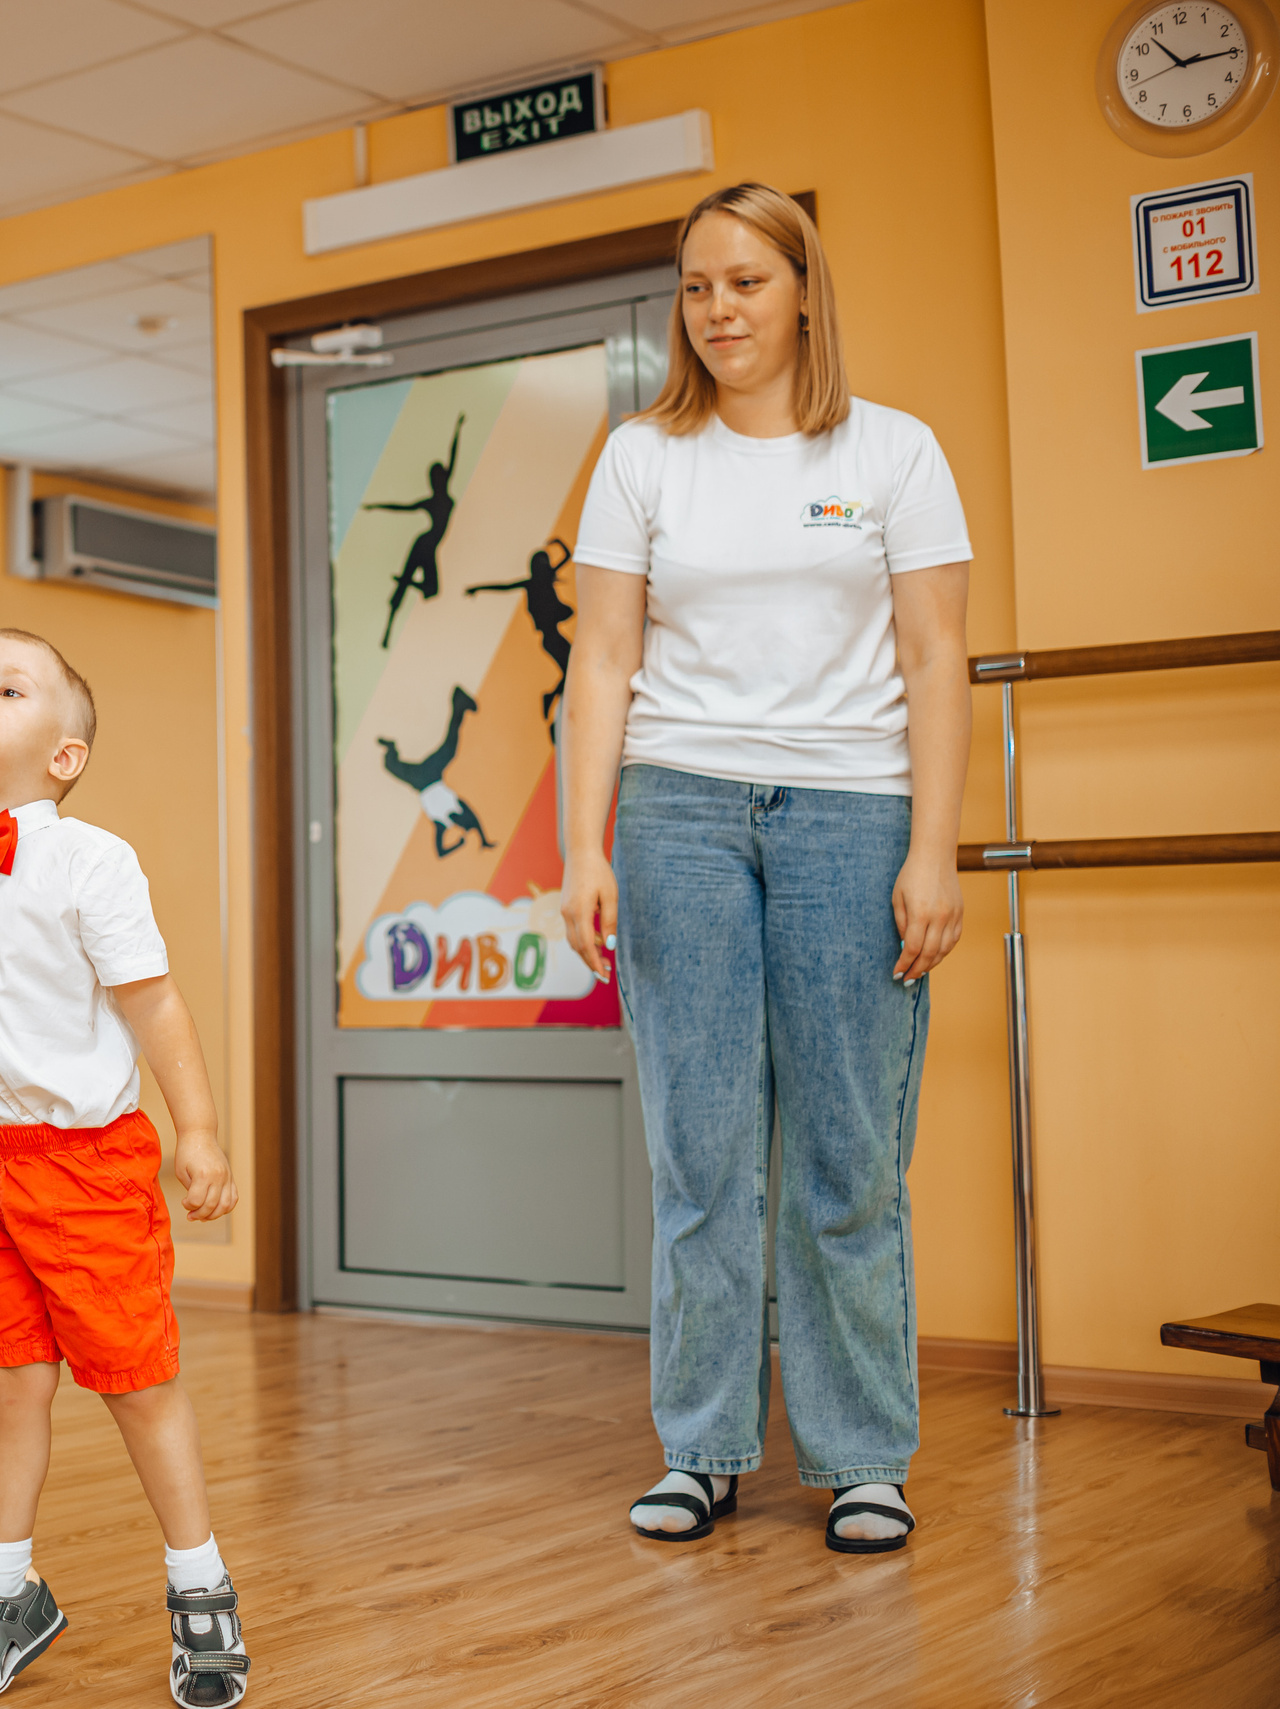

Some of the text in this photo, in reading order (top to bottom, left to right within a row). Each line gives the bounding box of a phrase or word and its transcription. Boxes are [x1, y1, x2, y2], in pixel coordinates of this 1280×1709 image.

[1172, 12, 1187, 25] 12
[1200, 12, 1207, 24] 1
[1151, 22, 1164, 35] 11
[1220, 24, 1229, 37] 2
[1135, 43, 1150, 56] 10
[1229, 47, 1239, 59] 3
[1130, 69, 1139, 81] 9
[1224, 71, 1233, 84] 4
[1139, 90, 1148, 102] 8
[1207, 93, 1216, 106] 5
[462, 84, 583, 134] ВЫХОД
[1159, 103, 1167, 116] 7
[1183, 105, 1192, 117] 6
[480, 115, 565, 150] EXIT
[1160, 209, 1194, 222] ПОЖАРЕ
[1195, 203, 1233, 215] ЗВОНИТЬ
[1182, 217, 1206, 237] 01
[1170, 236, 1226, 252] МОБИЛЬНОГО
[1170, 249, 1224, 281] 112
